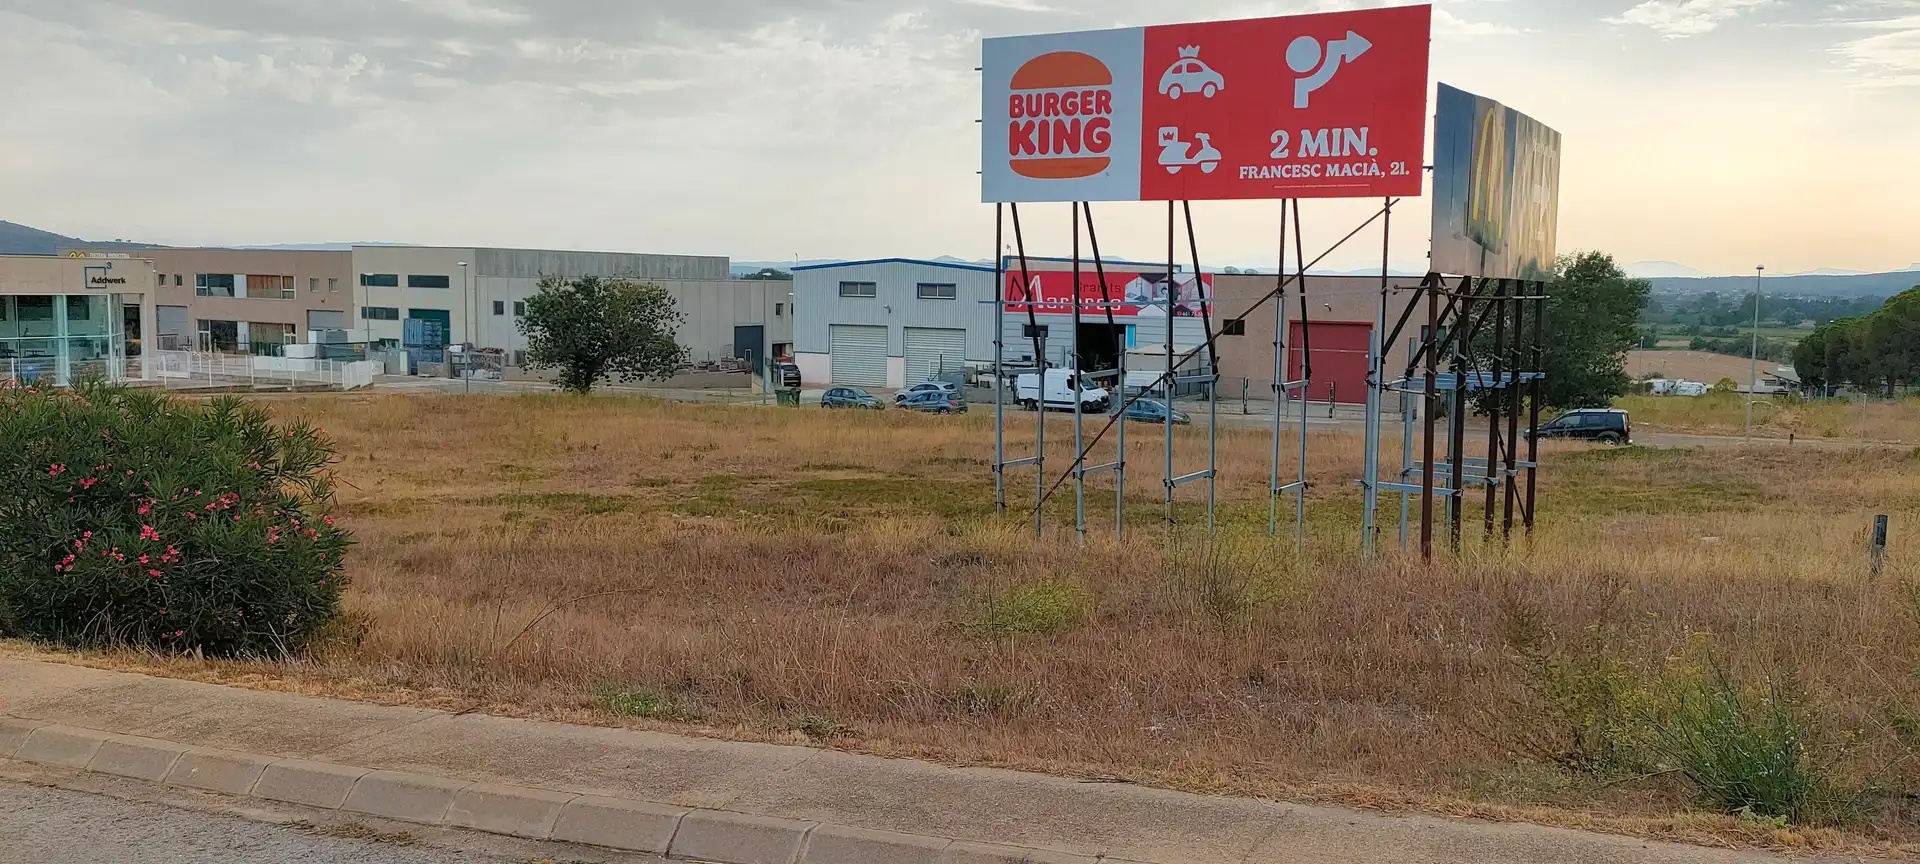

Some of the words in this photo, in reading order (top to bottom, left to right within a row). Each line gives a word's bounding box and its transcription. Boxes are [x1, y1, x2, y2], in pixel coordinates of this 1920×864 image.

[1009, 90, 1113, 118] BURGER
[1009, 117, 1112, 156] KING
[1270, 130, 1290, 159] 2
[1297, 127, 1378, 157] MIN.
[1239, 164, 1321, 179] FRANCESC
[1325, 158, 1386, 178] MACIÀ,
[1390, 161, 1410, 176] 21.
